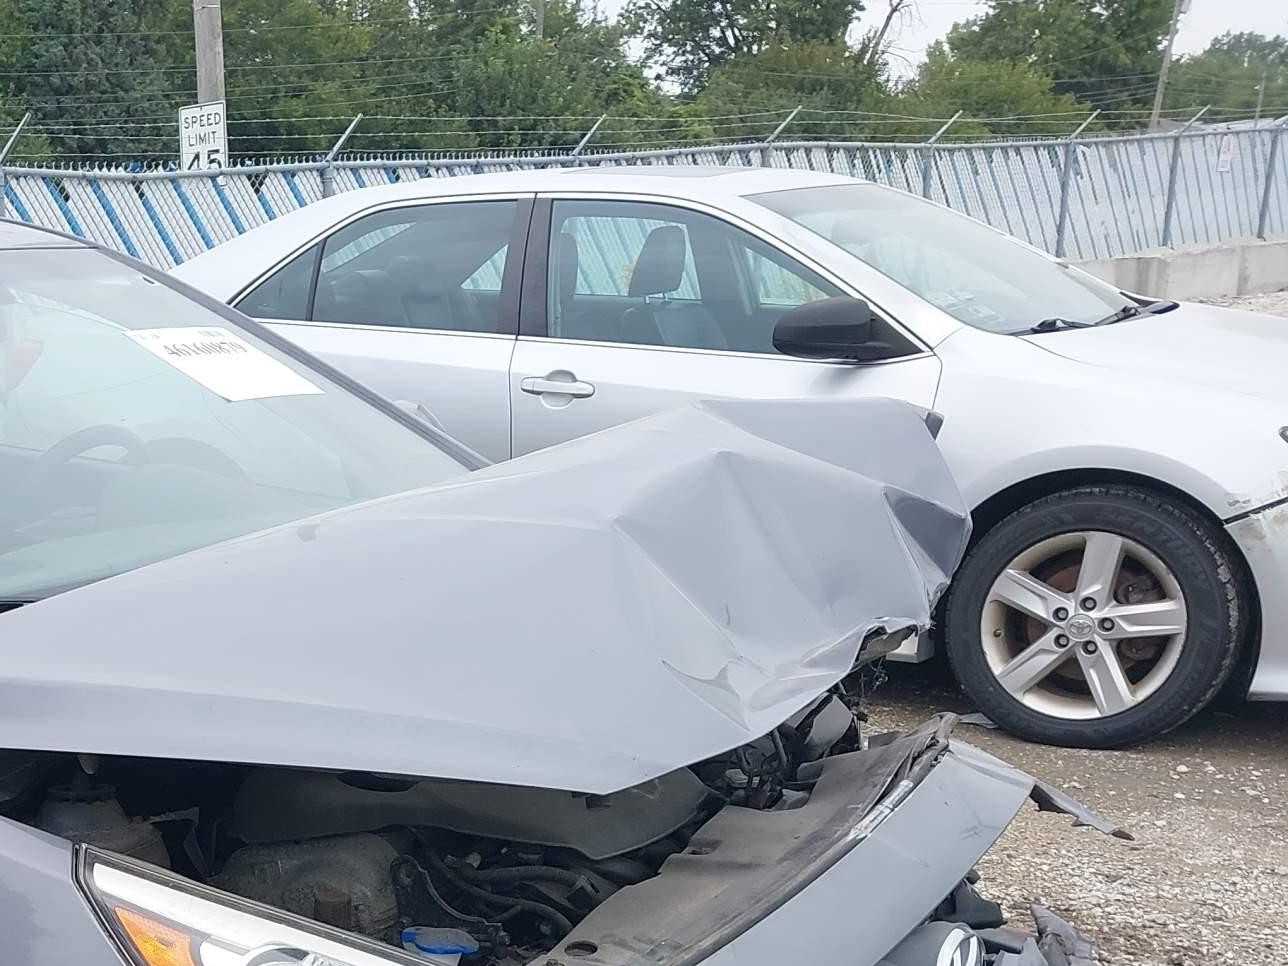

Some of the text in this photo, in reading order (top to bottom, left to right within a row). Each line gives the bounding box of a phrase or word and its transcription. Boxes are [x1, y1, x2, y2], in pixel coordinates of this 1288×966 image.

[183, 112, 222, 130] SPEED
[187, 131, 217, 147] LIMIT
[187, 148, 222, 170] 45
[163, 341, 248, 358] 46160879
